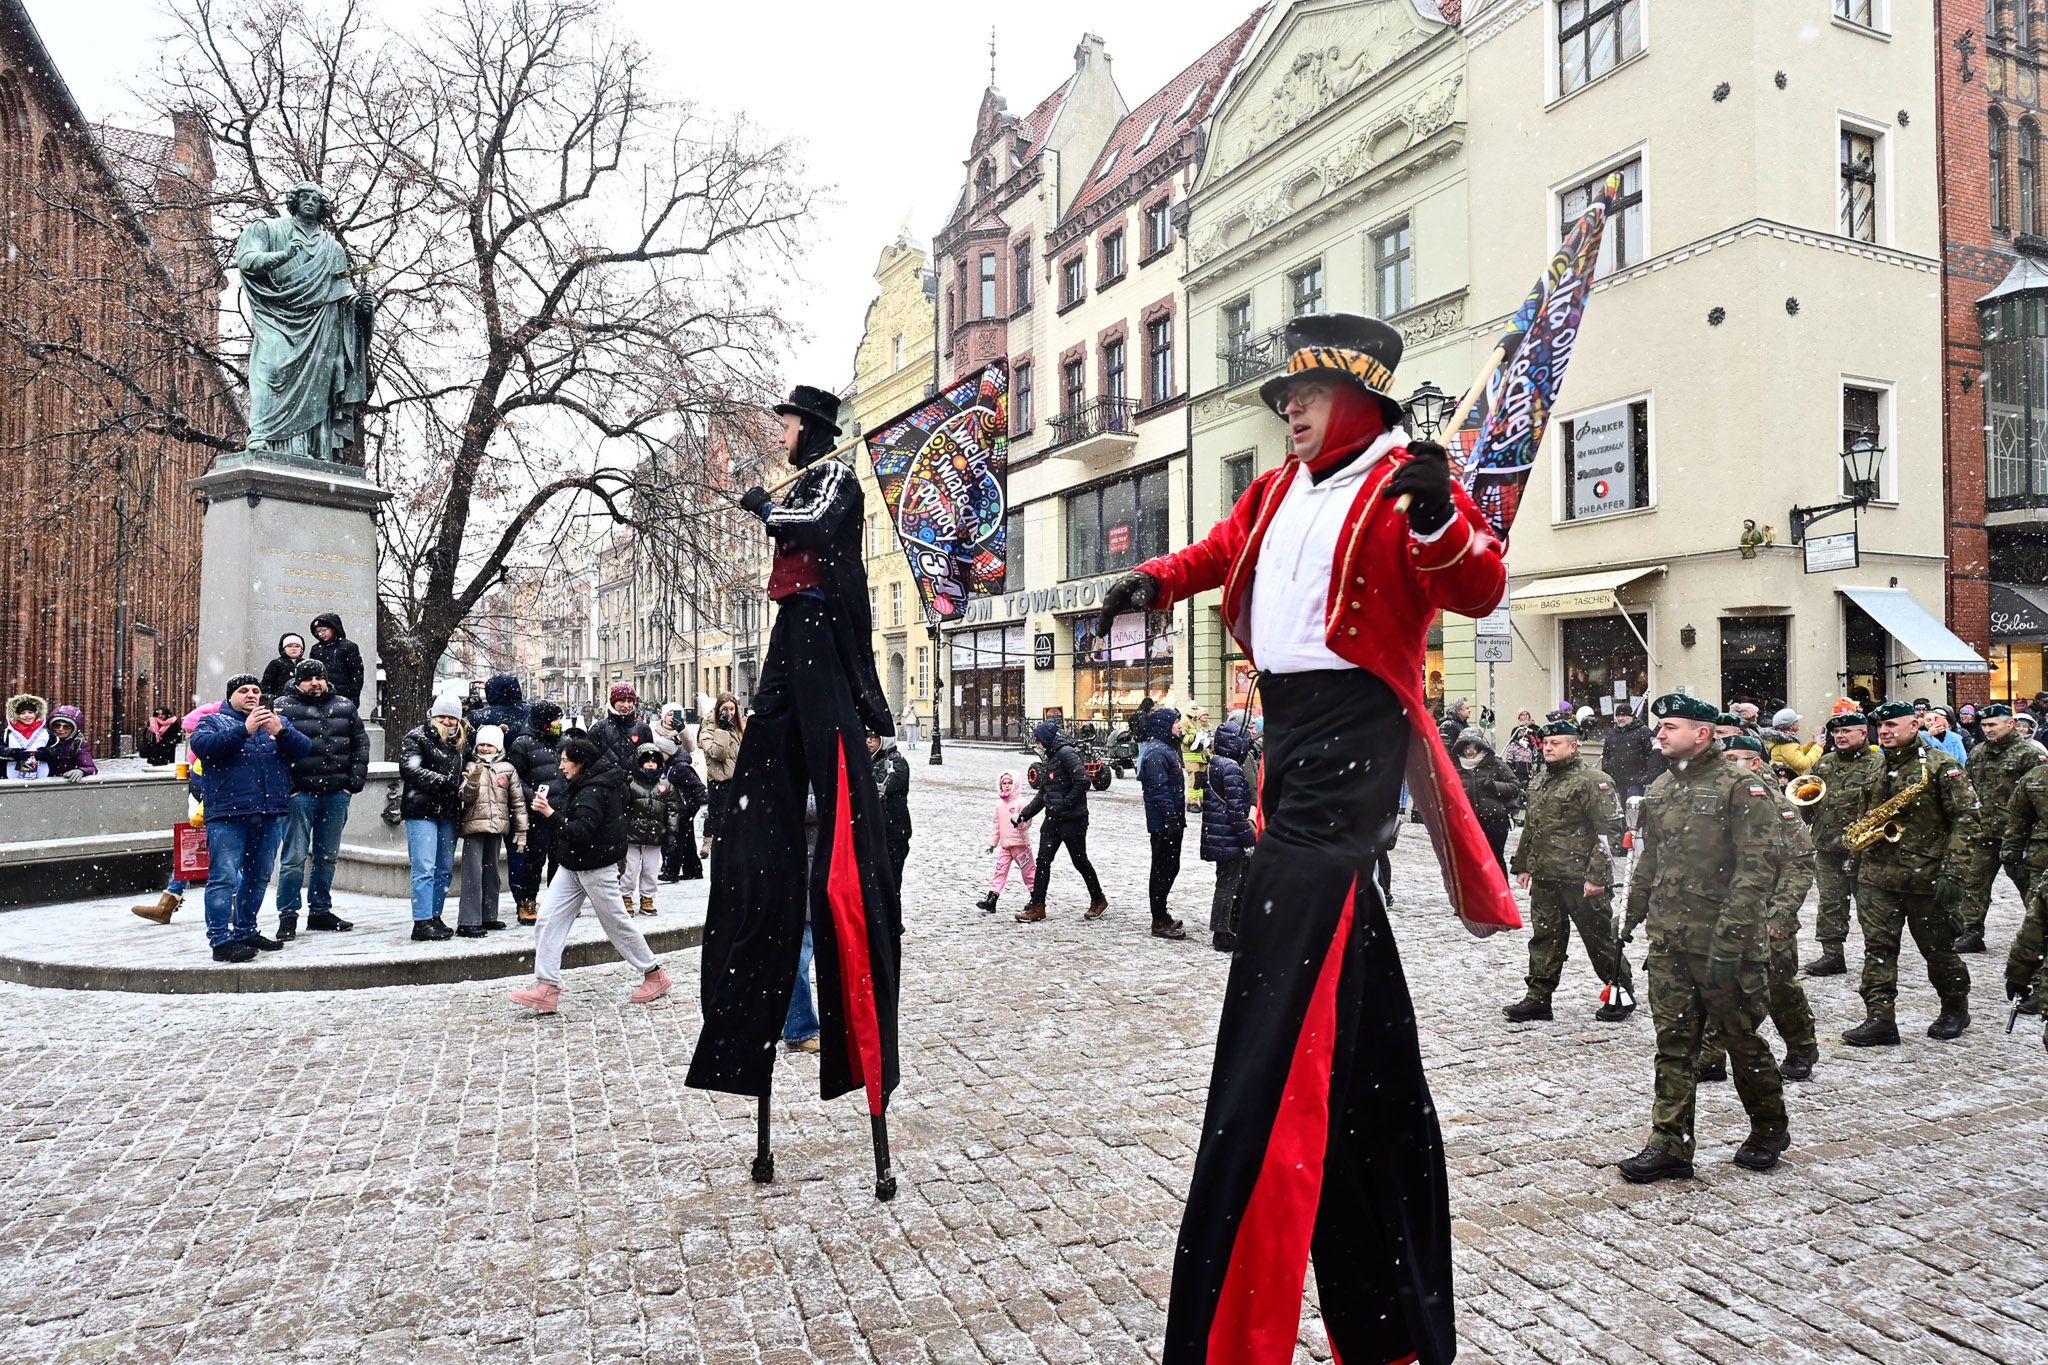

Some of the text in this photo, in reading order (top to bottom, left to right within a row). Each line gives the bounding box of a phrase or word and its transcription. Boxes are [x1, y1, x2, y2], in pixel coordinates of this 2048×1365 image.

[1591, 420, 1624, 436] PARKER
[1588, 441, 1624, 457] WATERMAN
[1578, 499, 1625, 515] SHEAFFER
[314, 552, 370, 566] COPERNICUS
[916, 550, 967, 601] 34
[953, 597, 993, 625] OM
[1510, 603, 1527, 612] EBKI
[1540, 599, 1561, 609] BAGS
[1573, 595, 1611, 606] TASCHEN
[1990, 611, 2038, 633] Lilou
[1489, 638, 1511, 647] dotyczy
